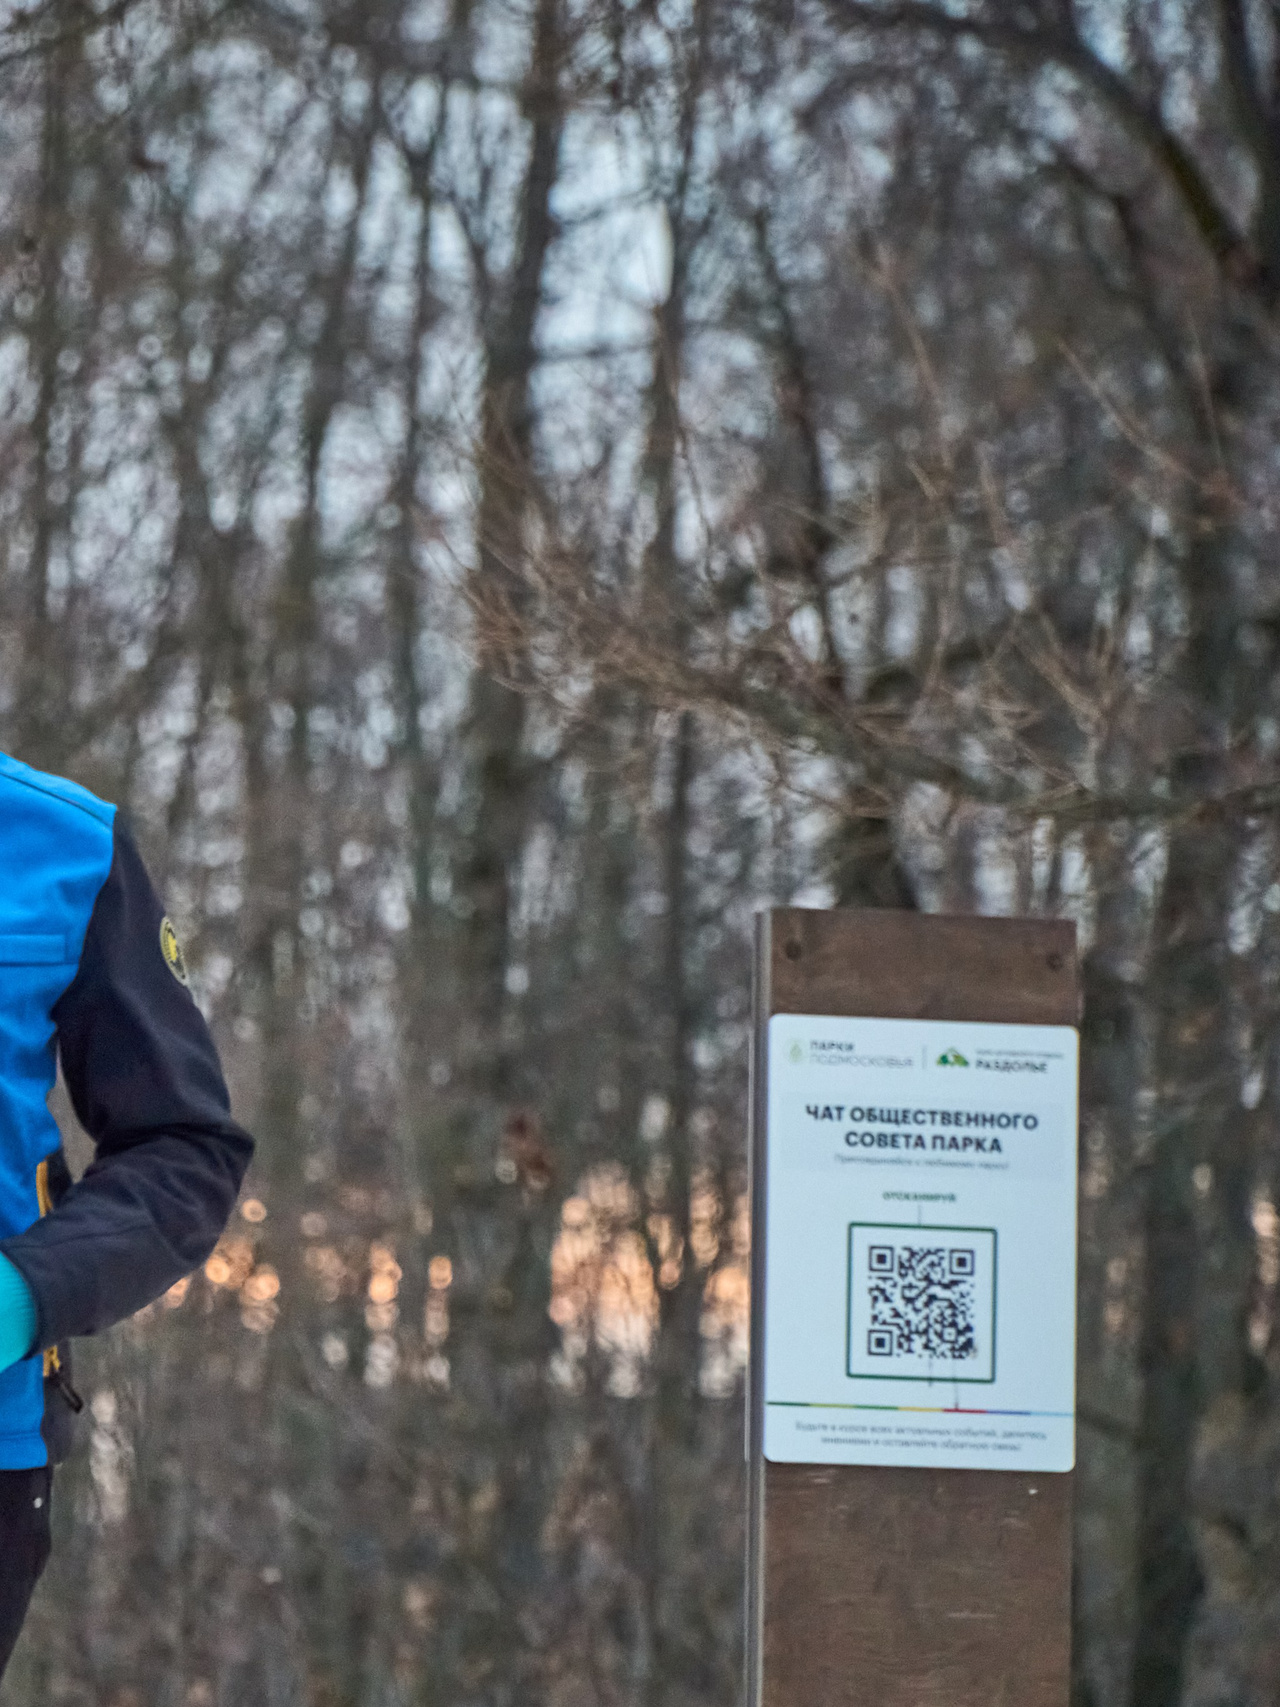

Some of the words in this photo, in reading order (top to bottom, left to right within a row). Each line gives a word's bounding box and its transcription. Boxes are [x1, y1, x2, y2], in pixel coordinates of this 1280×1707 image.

[809, 1040, 854, 1052] ПАРКИ
[805, 1104, 844, 1122] ЧАТ
[849, 1106, 1039, 1131] ОБЩЕСТВЕННОГО
[844, 1130, 926, 1151] СОВЕТА
[931, 1134, 1003, 1154] ПАРКА
